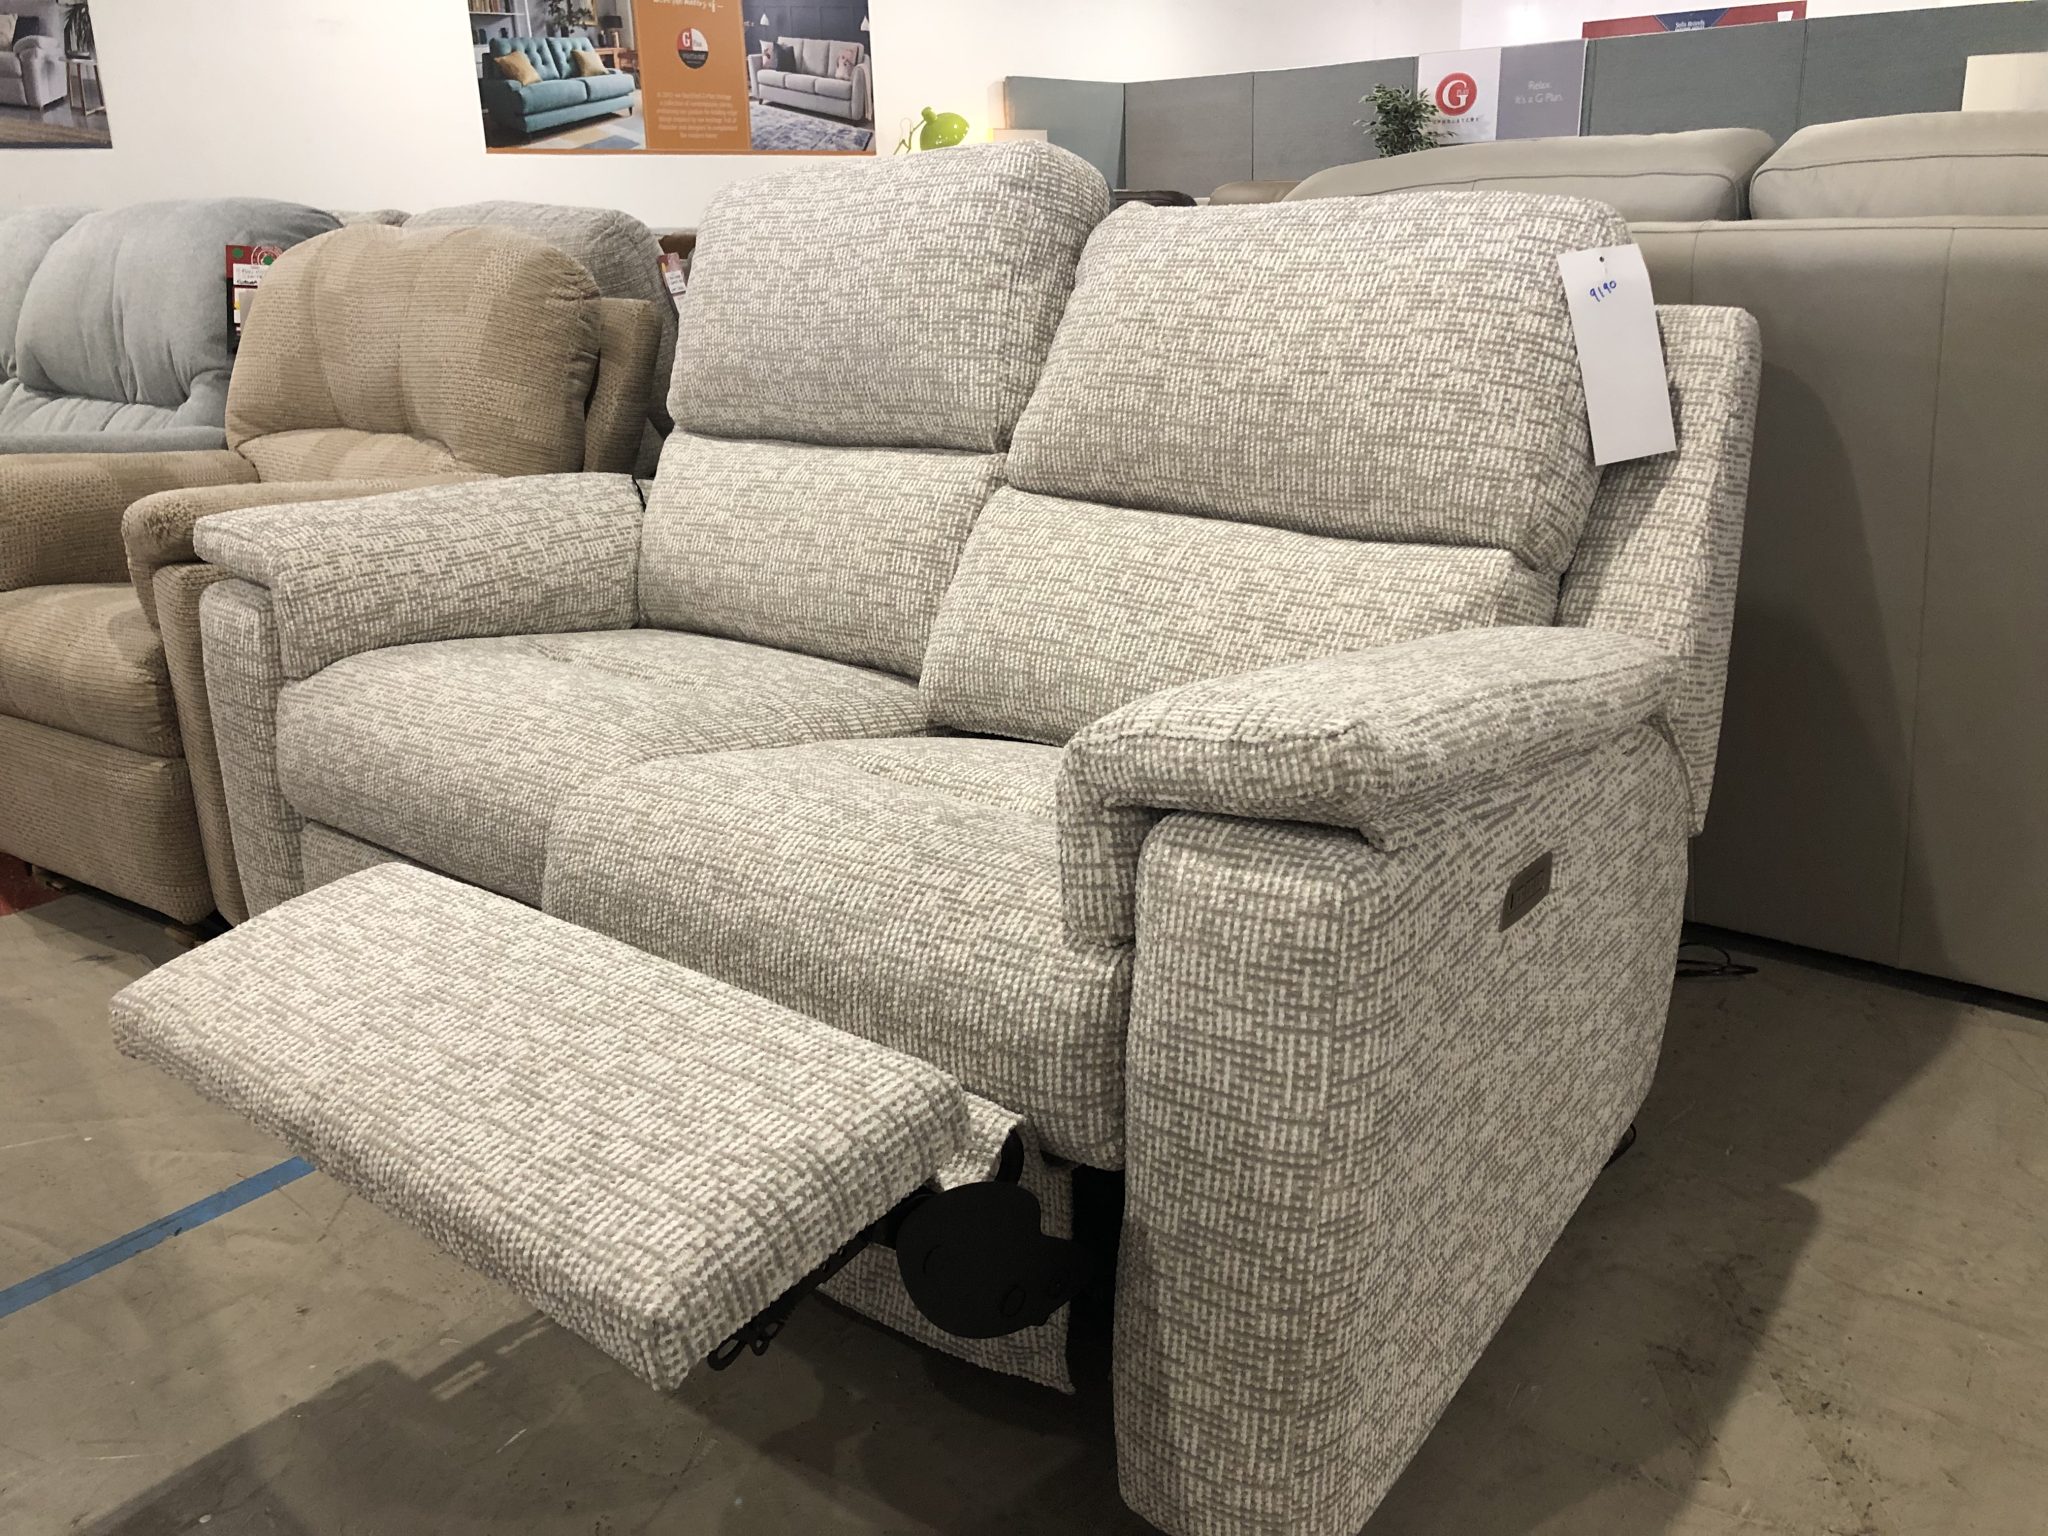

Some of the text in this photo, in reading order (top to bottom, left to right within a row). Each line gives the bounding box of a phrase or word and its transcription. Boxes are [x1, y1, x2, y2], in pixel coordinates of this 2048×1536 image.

[682, 31, 691, 47] G
[1442, 80, 1468, 109] G
[1534, 92, 1544, 104] G
[1589, 280, 1617, 303] 9190
